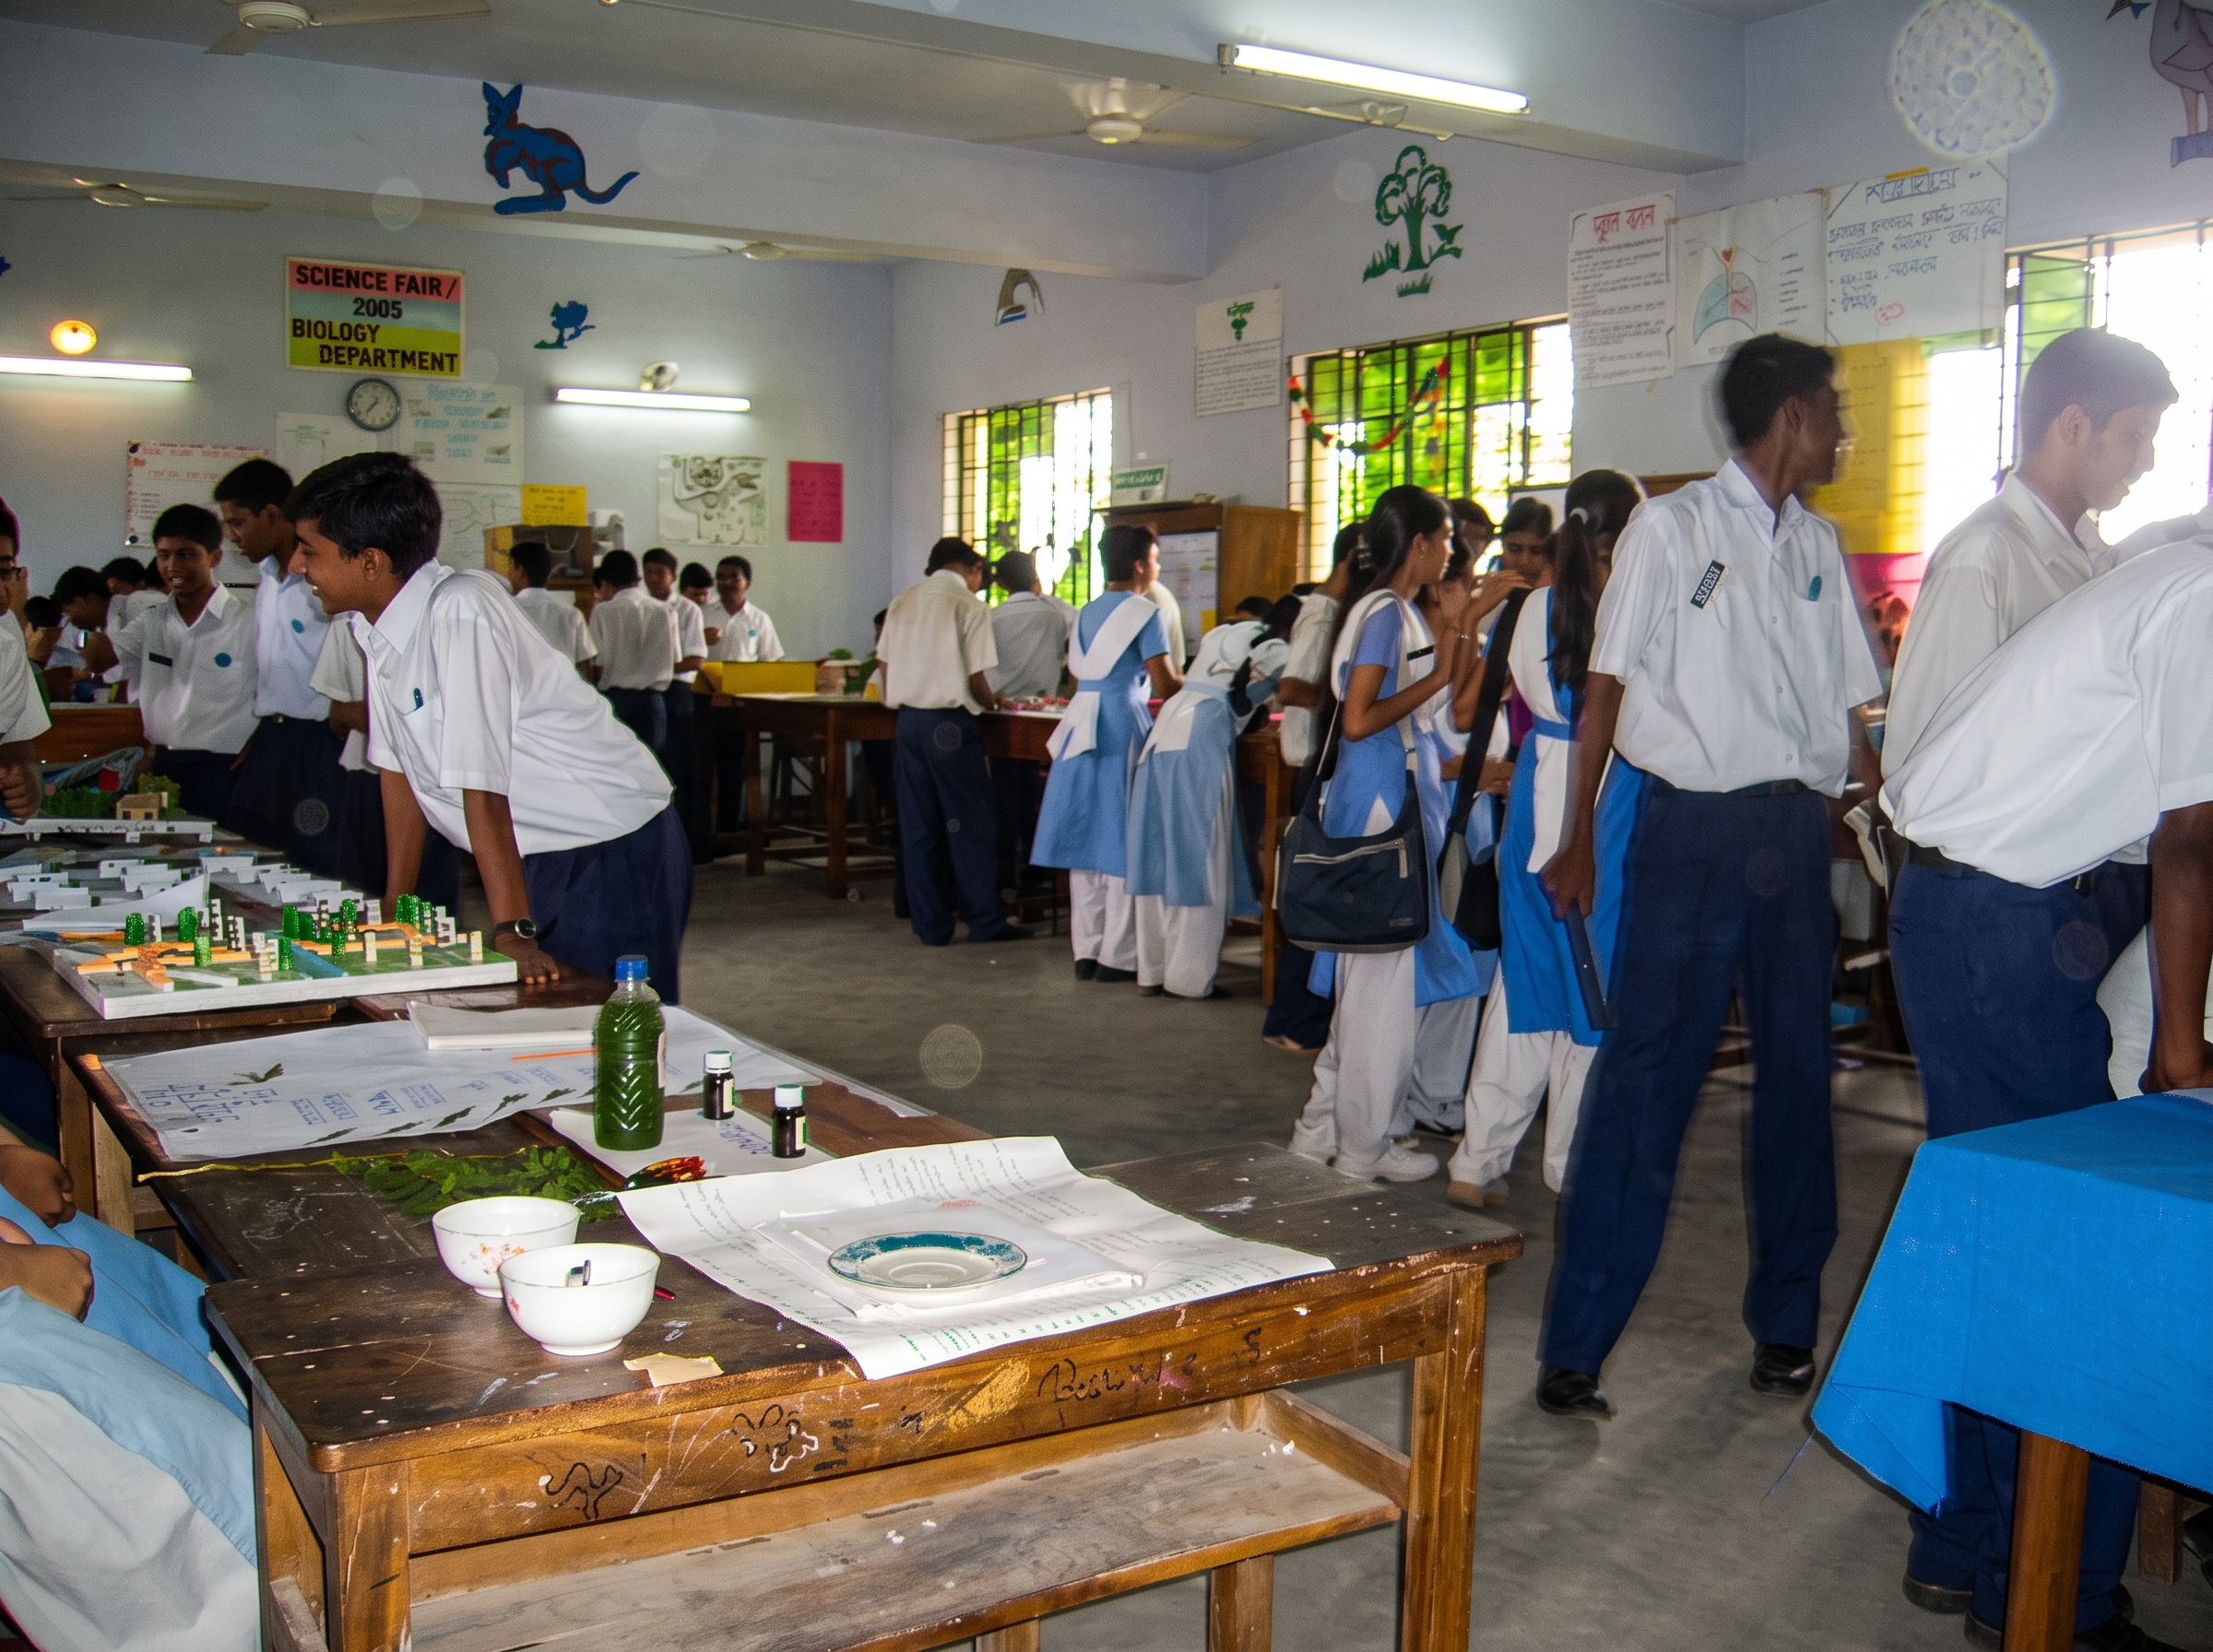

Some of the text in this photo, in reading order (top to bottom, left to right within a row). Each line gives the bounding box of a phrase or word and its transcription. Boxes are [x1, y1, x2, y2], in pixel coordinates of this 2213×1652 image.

[296, 265, 387, 291] SCIENCE
[353, 297, 403, 319] 2005
[292, 318, 380, 344] BIOLOGY
[319, 345, 458, 372] DEPARTMENT
